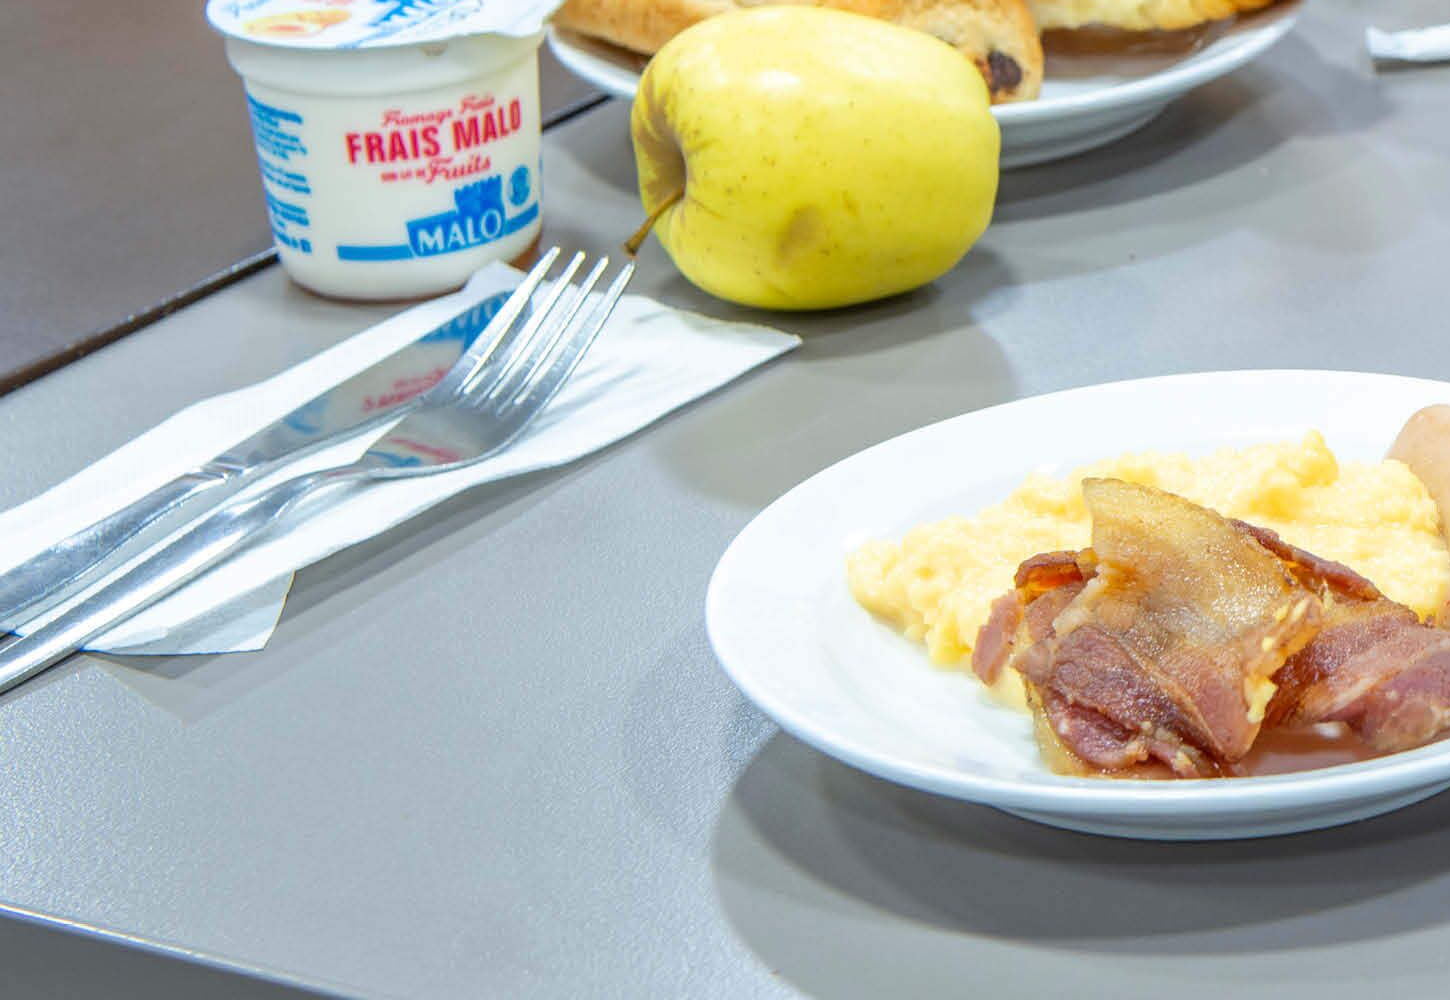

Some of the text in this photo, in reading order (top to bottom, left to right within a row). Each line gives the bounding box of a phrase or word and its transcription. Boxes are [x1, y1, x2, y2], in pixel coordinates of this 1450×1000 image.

[346, 99, 521, 163] FRAIS MALO
[425, 155, 491, 184] Fruits
[418, 209, 502, 253] MALO
